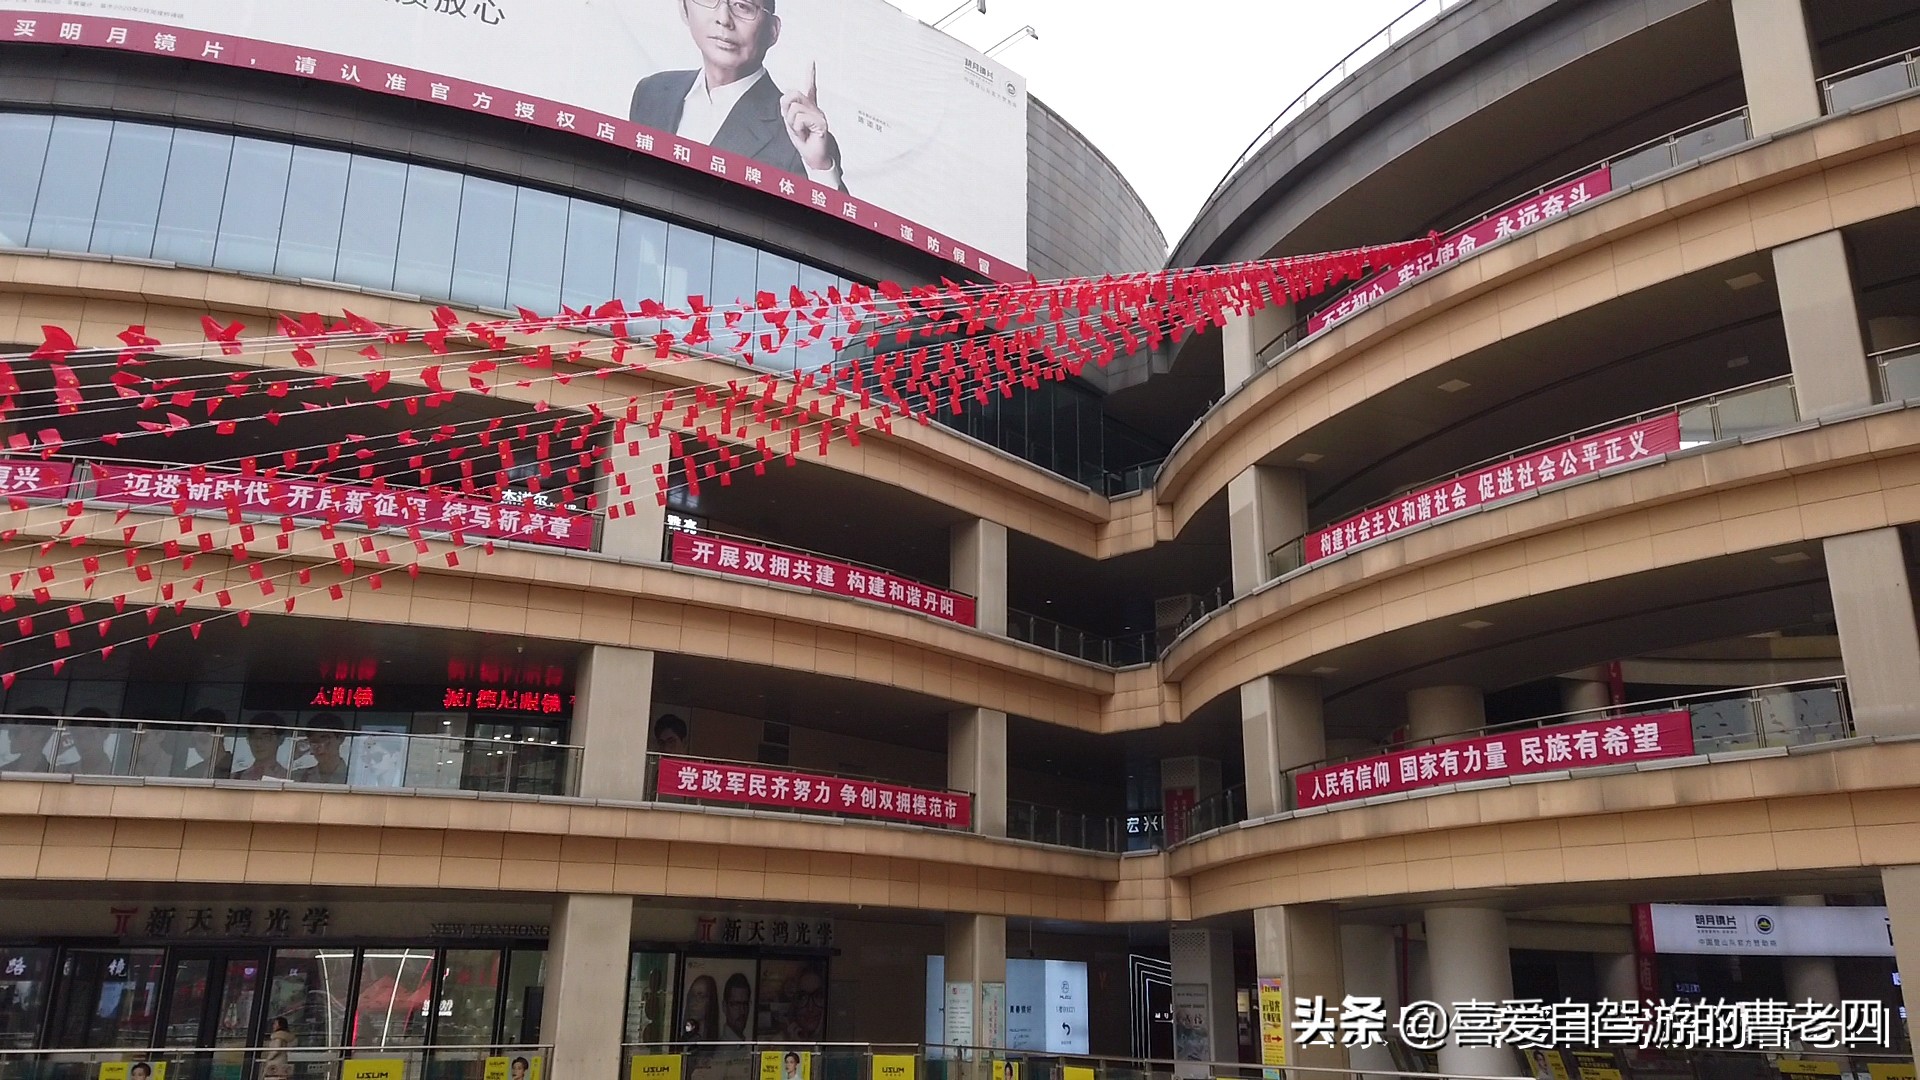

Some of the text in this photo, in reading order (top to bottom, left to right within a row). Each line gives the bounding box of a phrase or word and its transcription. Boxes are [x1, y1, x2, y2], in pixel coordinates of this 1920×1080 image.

[1397, 233, 1478, 287] 牢记使命
[1493, 182, 1592, 238] 永远奋斗
[122, 472, 271, 506] 迈进新时代
[1319, 429, 1650, 558] 构建社会主义和谐社会 促进社会公平正义
[691, 540, 956, 618] 开展双拥共建 构建和谐丹阳
[677, 765, 958, 820] 党政军民齐努力 争创双拥模范市
[1310, 721, 1664, 801] 人民有信仰 国家有力量 民族有希望
[145, 906, 331, 937] 新天鸿光学
[722, 917, 834, 945] 新天鸿光学
